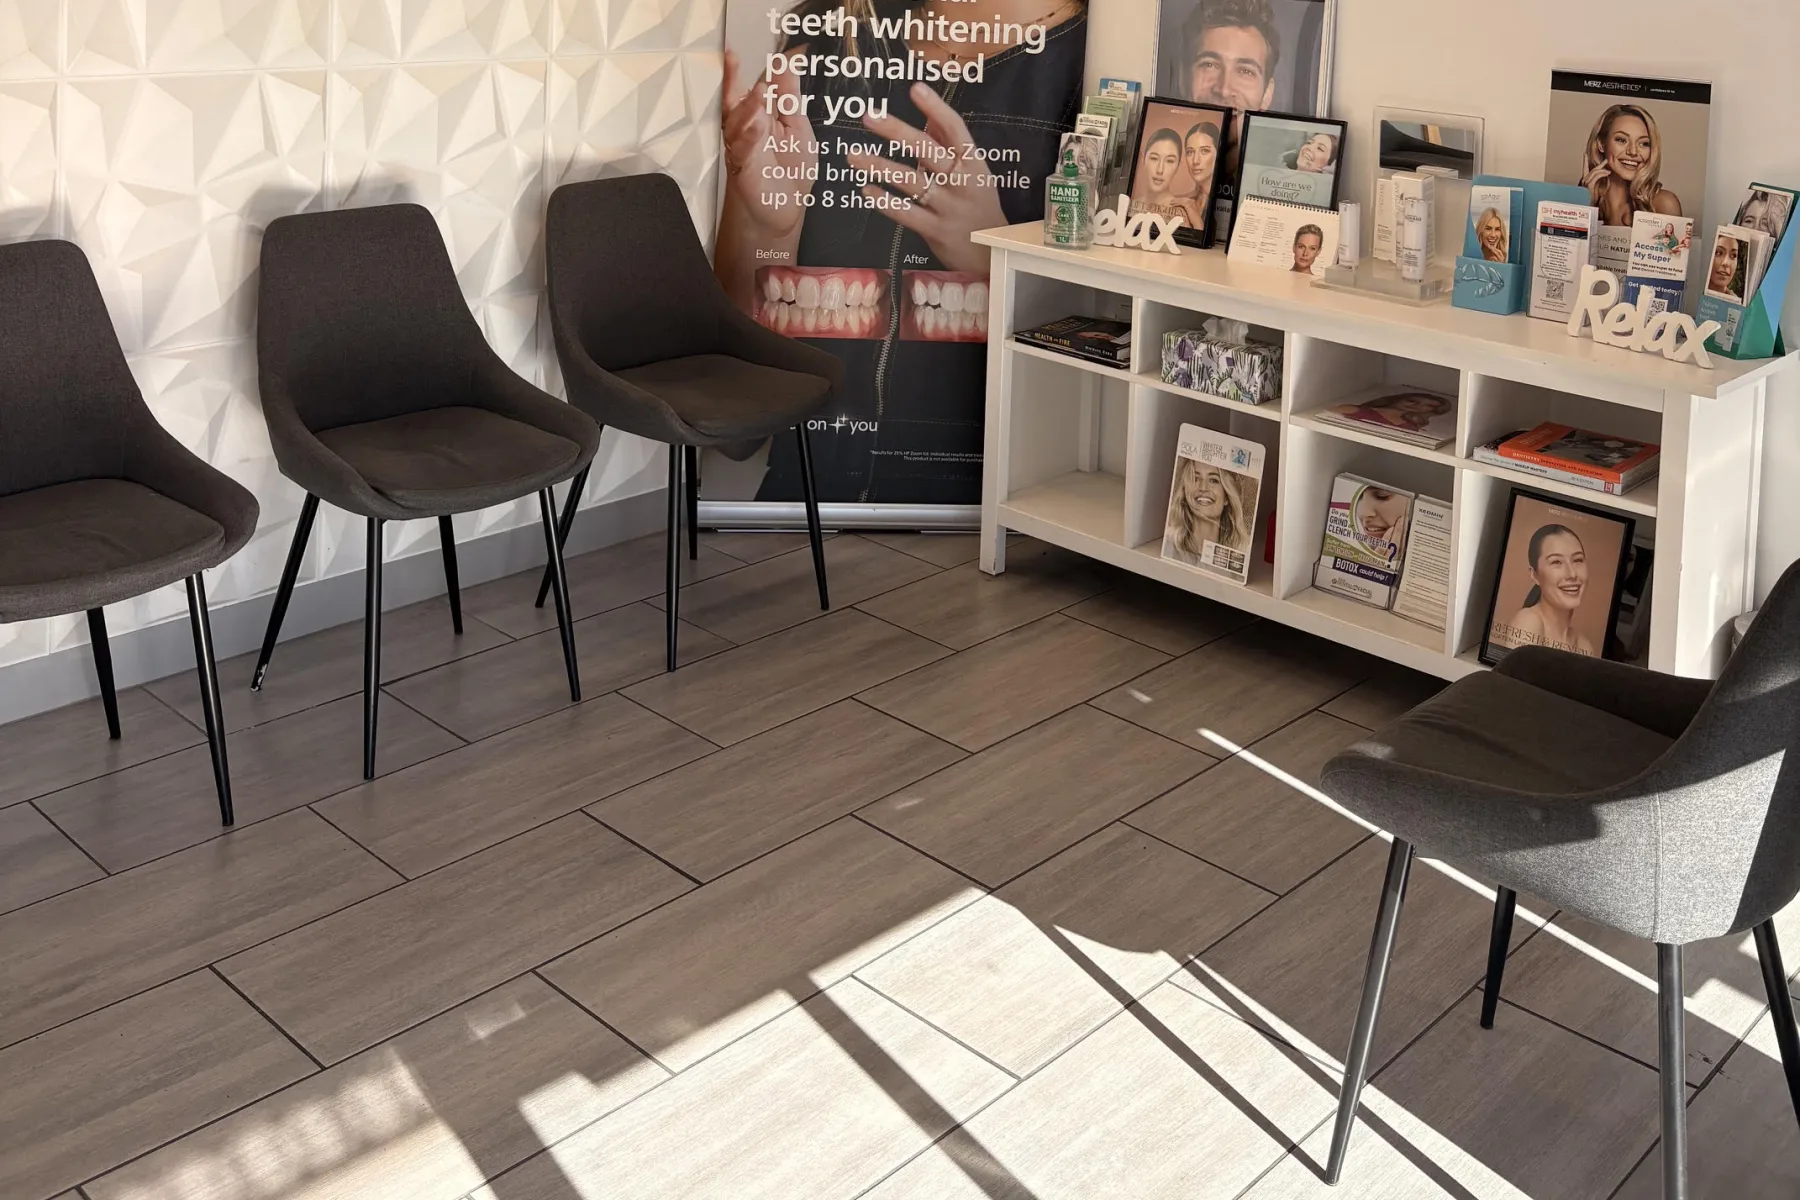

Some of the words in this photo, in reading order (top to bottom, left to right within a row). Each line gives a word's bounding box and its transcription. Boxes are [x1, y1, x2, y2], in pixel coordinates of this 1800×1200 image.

[766, 6, 858, 38] teeth
[870, 10, 1047, 54] whitening
[765, 49, 985, 84] personalised
[1584, 79, 1601, 88] MERZ
[762, 84, 815, 116] for
[823, 94, 888, 125] you
[763, 135, 801, 154] Ask
[807, 141, 830, 155] us
[836, 137, 883, 157] how
[889, 140, 956, 163] Philips
[961, 143, 1021, 163] Zoom
[761, 161, 819, 182] could
[825, 163, 917, 188] brighten
[922, 170, 971, 191] your
[976, 167, 1031, 189] smile
[1261, 176, 1281, 186] How
[1282, 180, 1297, 189] are
[1298, 183, 1312, 191] we
[1050, 185, 1080, 197] HAND
[1270, 188, 1299, 200] doing?
[760, 193, 787, 211] up
[793, 191, 815, 207] to
[822, 191, 835, 208] 8
[1092, 190, 1184, 254] elax
[755, 249, 790, 260] Before
[903, 254, 929, 264] After
[1635, 241, 1664, 253] Access
[1633, 251, 1645, 260] My
[1647, 253, 1671, 263] Super
[1567, 264, 1721, 369] Relax
[807, 419, 827, 431] on
[850, 420, 878, 435] you
[1329, 515, 1348, 527] GRIND
[1328, 524, 1352, 537] CLENCH
[1352, 531, 1369, 543] YOUR
[1370, 535, 1387, 548] TEETH
[1335, 558, 1360, 574] BOTOX
[1359, 568, 1374, 576] could
[1492, 621, 1541, 645] REFRESH
